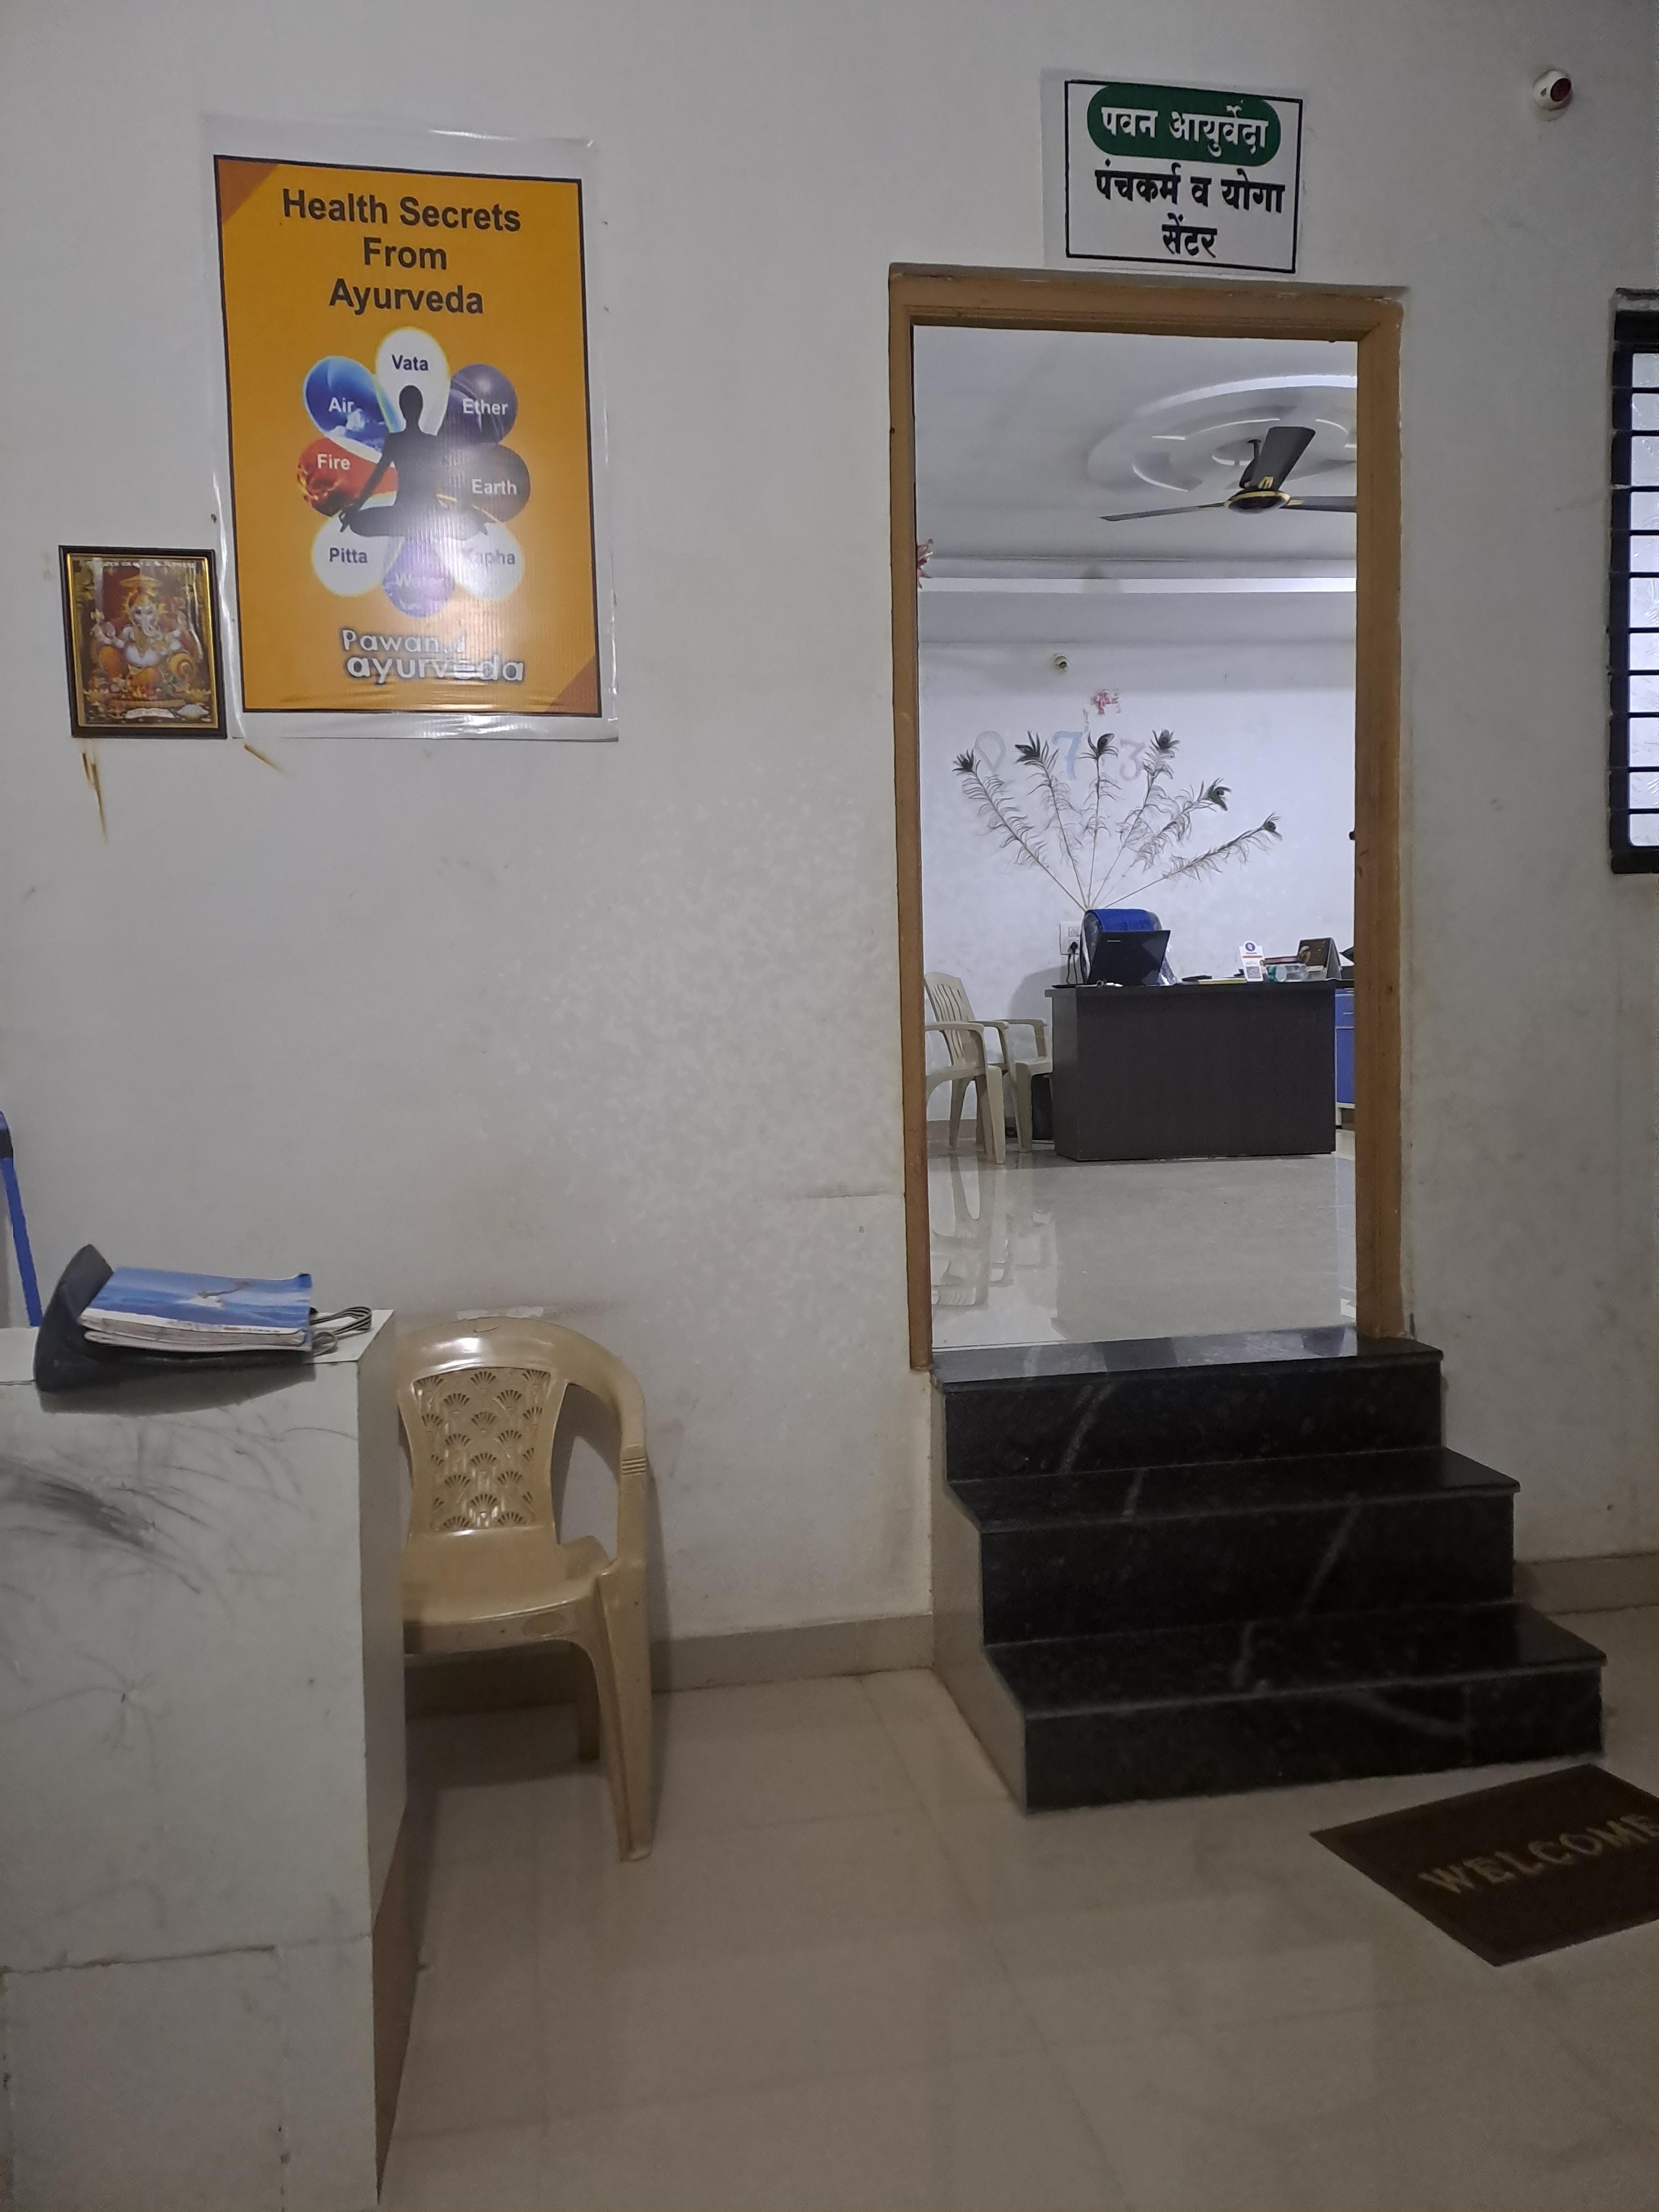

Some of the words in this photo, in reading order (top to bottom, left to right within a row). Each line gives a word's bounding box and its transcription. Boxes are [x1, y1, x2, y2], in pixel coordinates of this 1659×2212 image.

[1094, 158, 1181, 205] पंचकर्म
[1190, 176, 1212, 207] व
[1221, 168, 1285, 213] योगा
[283, 189, 388, 224] Health
[399, 196, 521, 232] Secrets
[1161, 212, 1218, 259] सेंटर
[363, 237, 447, 270] From
[330, 278, 484, 316] Ayurveda
[392, 354, 429, 372] Vata
[328, 397, 354, 414] Air
[462, 399, 508, 416] Ether
[317, 453, 351, 471] Fire
[472, 479, 517, 495] Earth
[329, 547, 368, 564] Pitta
[347, 651, 525, 683] ayurveda
[1417, 1813, 1659, 1894] WELCOME
